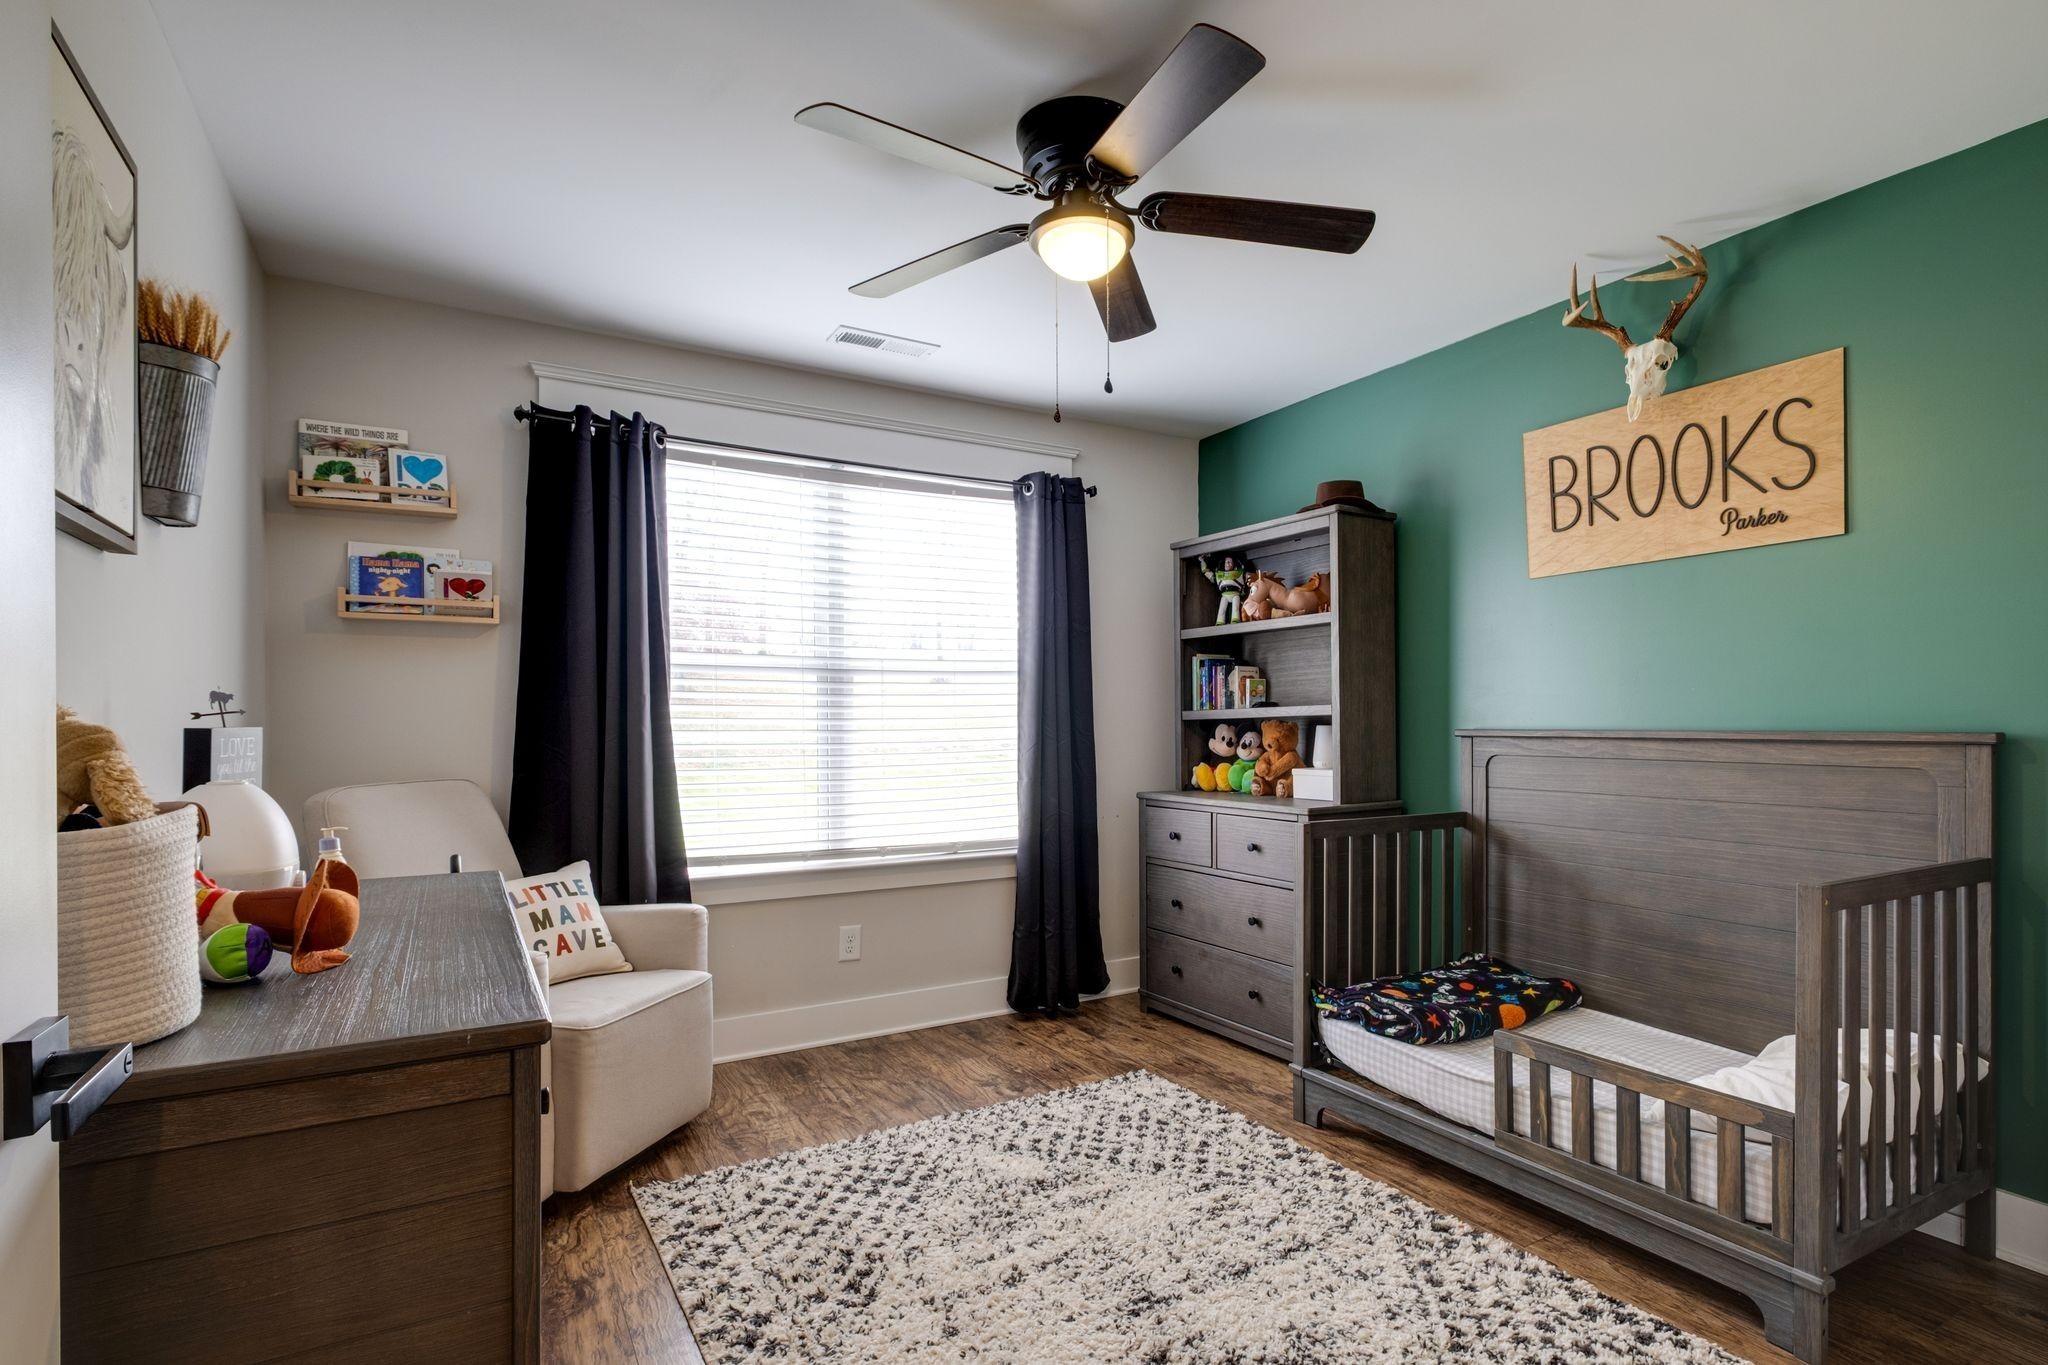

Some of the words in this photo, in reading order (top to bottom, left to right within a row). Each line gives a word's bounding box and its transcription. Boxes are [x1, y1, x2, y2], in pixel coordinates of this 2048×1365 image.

[305, 423, 328, 433] WHERE
[330, 425, 342, 435] THE
[344, 427, 360, 436] WILD
[361, 429, 385, 439] THINGS
[386, 431, 399, 441] ARE
[1549, 398, 1815, 532] BROOKS
[1720, 507, 1789, 536] Parker
[220, 736, 256, 757] LOVE
[509, 879, 589, 909] LITTLE
[529, 902, 593, 932] MAN
[533, 928, 606, 958] CAVE
